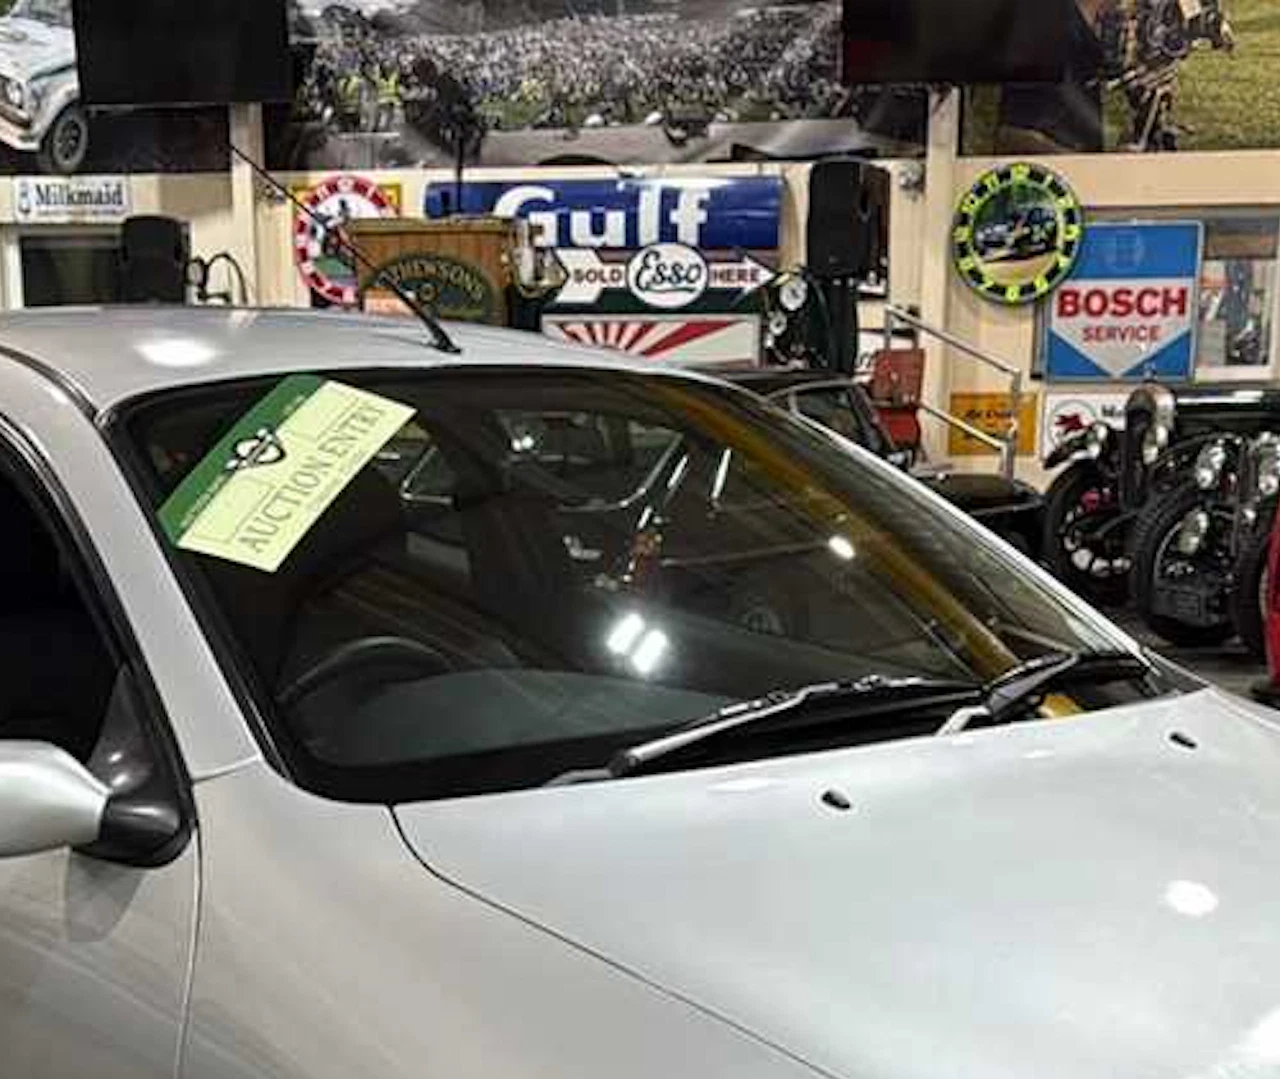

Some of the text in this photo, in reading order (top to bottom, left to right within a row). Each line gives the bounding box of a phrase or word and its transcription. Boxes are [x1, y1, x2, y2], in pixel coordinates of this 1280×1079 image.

[35, 183, 123, 205] Milkmaid
[492, 181, 710, 247] Gulf
[573, 250, 761, 293] SOLD Esso HERE
[1058, 286, 1188, 318] BOSCH
[1082, 324, 1162, 342] SERVICE
[237, 454, 331, 553] AUCTION
